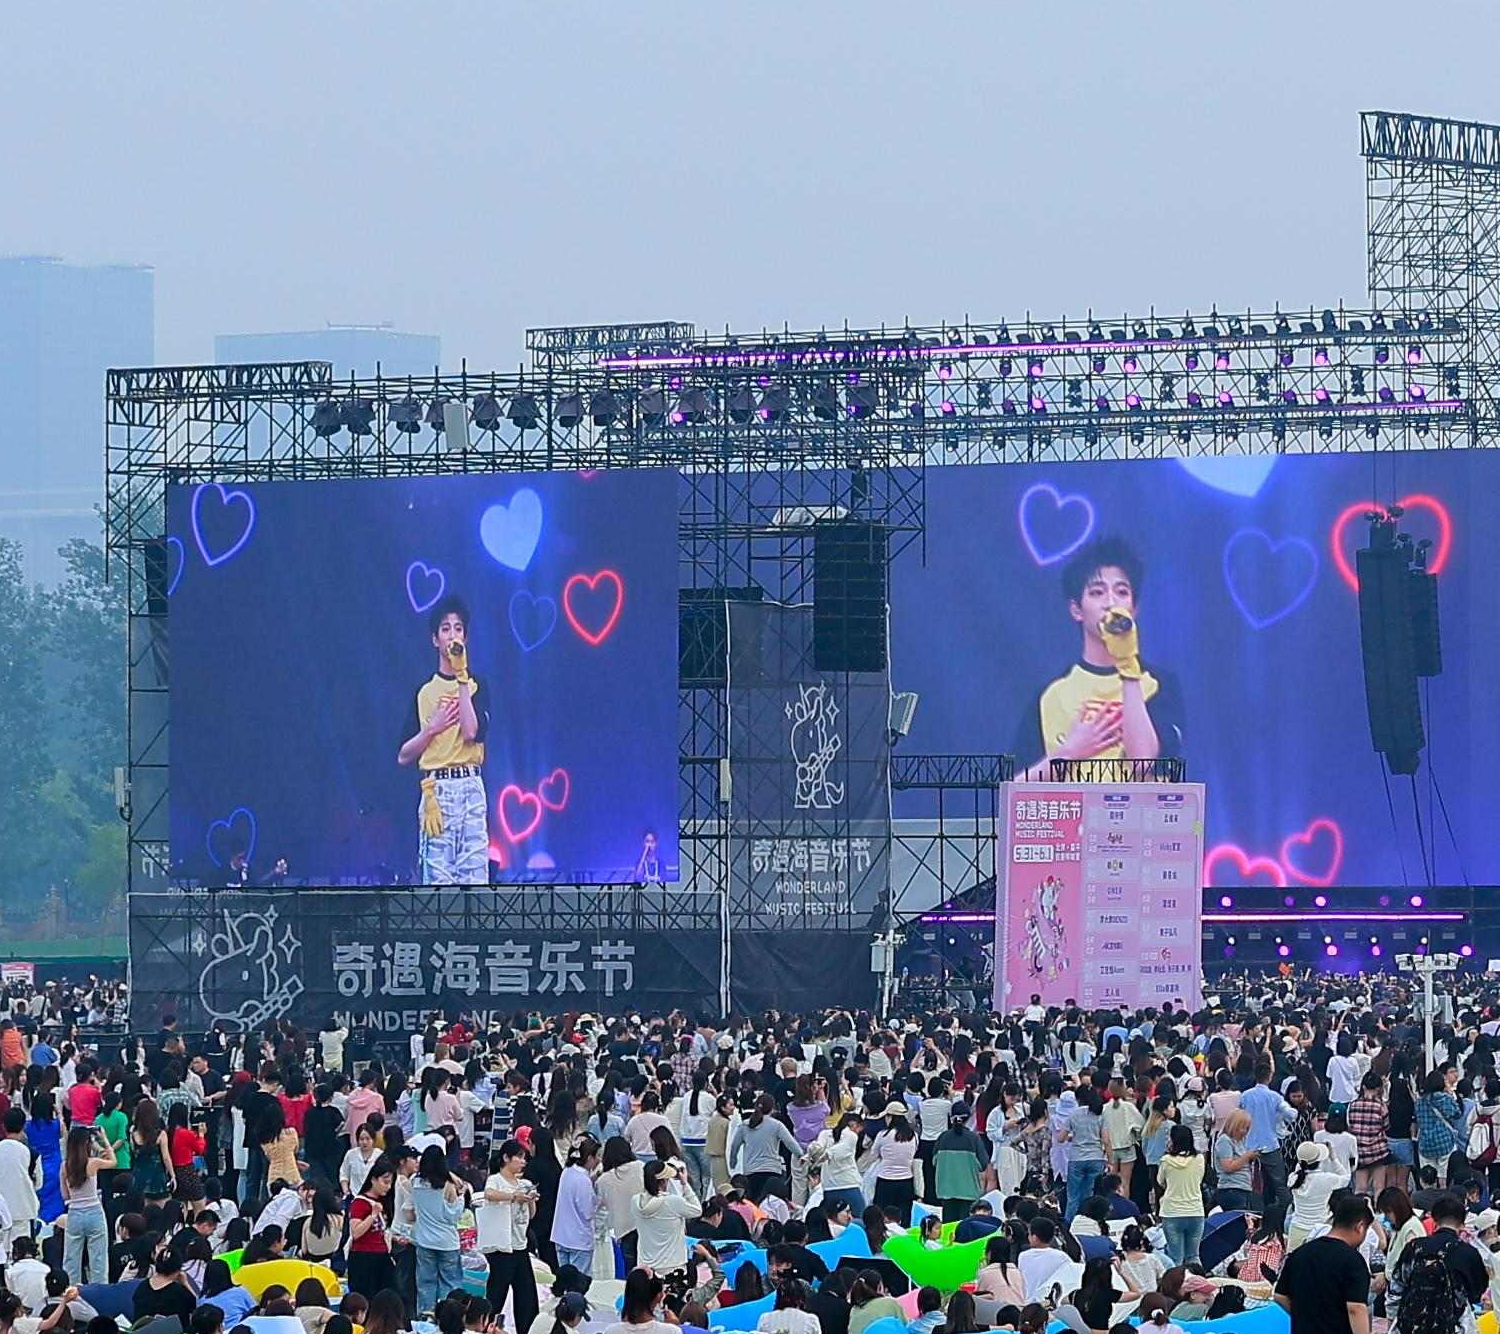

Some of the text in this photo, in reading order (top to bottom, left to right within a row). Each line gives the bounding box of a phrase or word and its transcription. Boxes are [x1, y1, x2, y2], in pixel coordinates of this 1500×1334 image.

[1015, 799, 1081, 821] 奇遇海音乐节
[751, 838, 872, 873] 奇遇海音乐节
[775, 880, 846, 894] WONDERLAND
[765, 901, 857, 915] MUSIC FESTIVAL
[332, 939, 636, 998] 奇遇海音乐节
